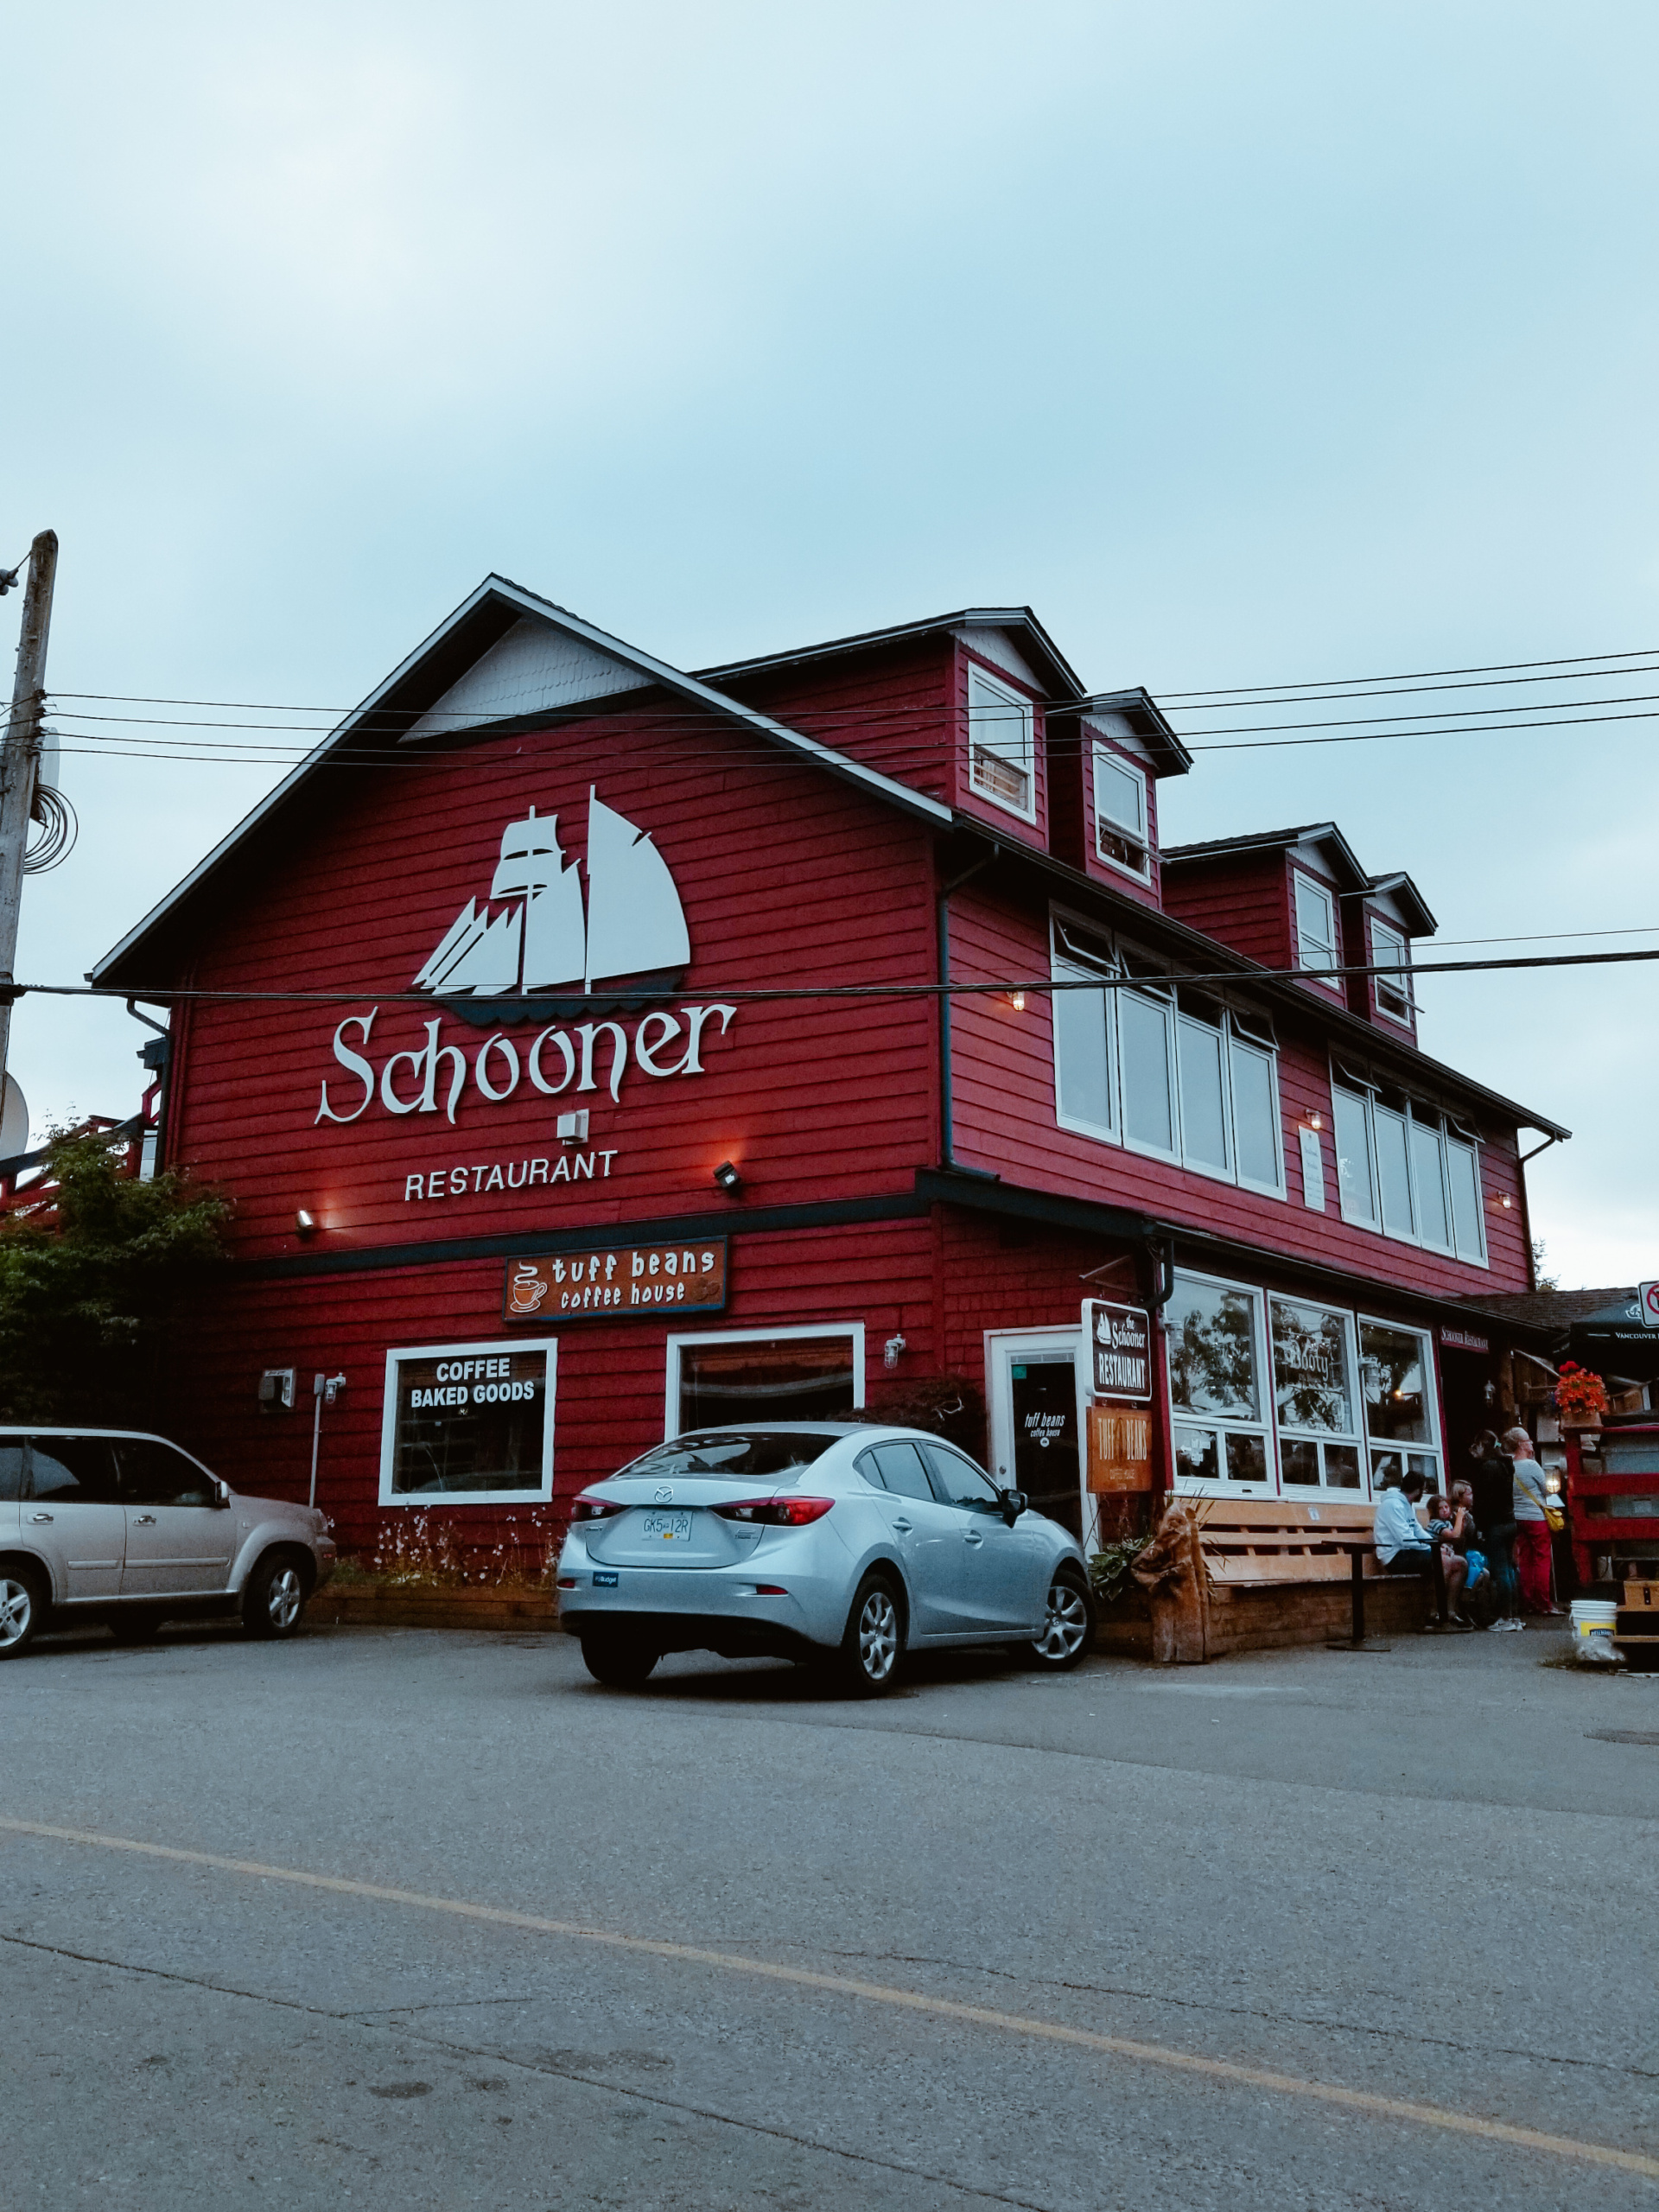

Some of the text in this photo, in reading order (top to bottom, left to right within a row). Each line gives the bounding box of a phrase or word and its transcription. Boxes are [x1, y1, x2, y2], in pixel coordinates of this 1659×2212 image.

[315, 1005, 737, 1124] Schooner
[404, 1149, 618, 1201] RESTAURANT
[552, 1250, 715, 1284] tuff beans
[561, 1281, 685, 1309] coffee house
[1112, 1322, 1146, 1350] Schooner
[1126, 1314, 1135, 1331] the
[436, 1357, 511, 1382] COFFEE
[1098, 1352, 1146, 1389] RESTAURANT
[411, 1381, 535, 1408] BAKED GOODS
[1025, 1412, 1065, 1427] tuff beans
[1098, 1418, 1147, 1460] TUFF BEANS
